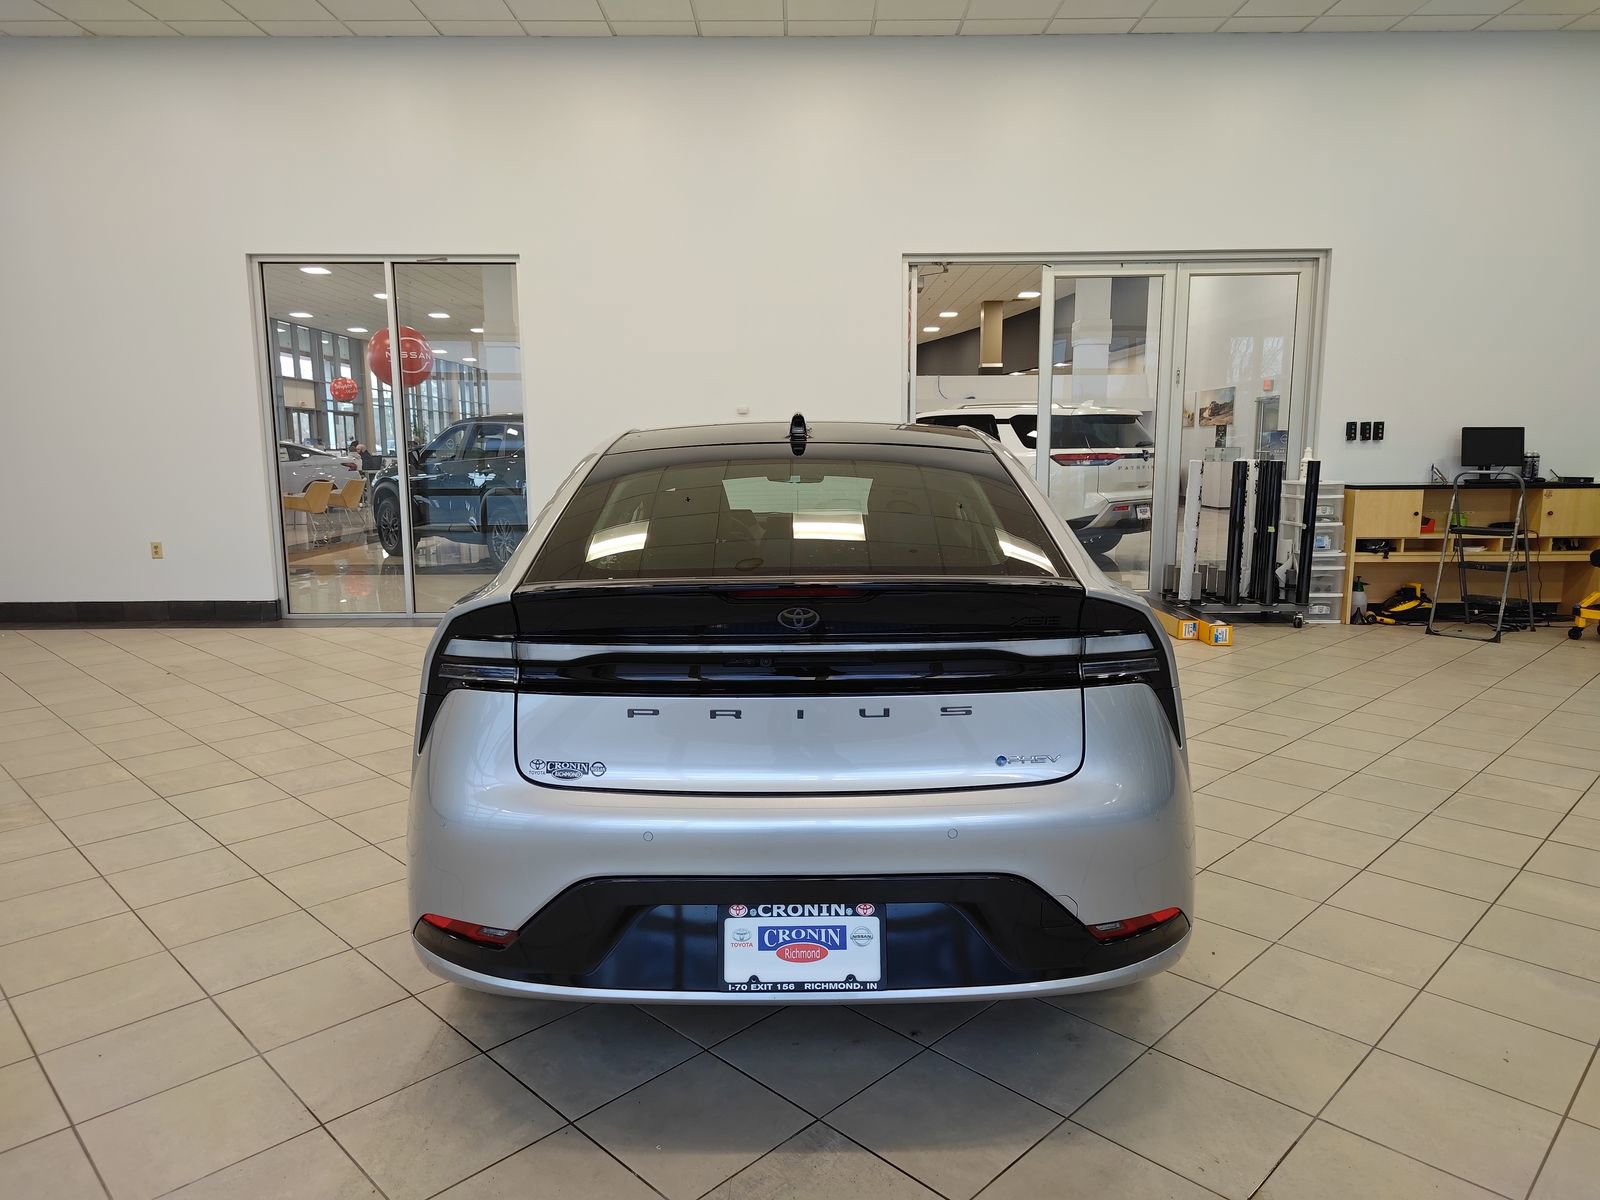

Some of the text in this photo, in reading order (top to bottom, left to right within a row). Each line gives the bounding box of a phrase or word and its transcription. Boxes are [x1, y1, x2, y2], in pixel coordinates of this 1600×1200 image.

[385, 352, 431, 360] NSSAN
[627, 705, 972, 719] PRIUS
[1007, 754, 1061, 764] PHEV
[547, 762, 588, 775] CRONIN
[757, 904, 846, 917] CRONIN
[763, 928, 841, 948] CRONIN
[784, 948, 821, 959] Richmond
[750, 983, 774, 991] EXIT
[776, 983, 795, 991] 156
[866, 982, 878, 990] IN
